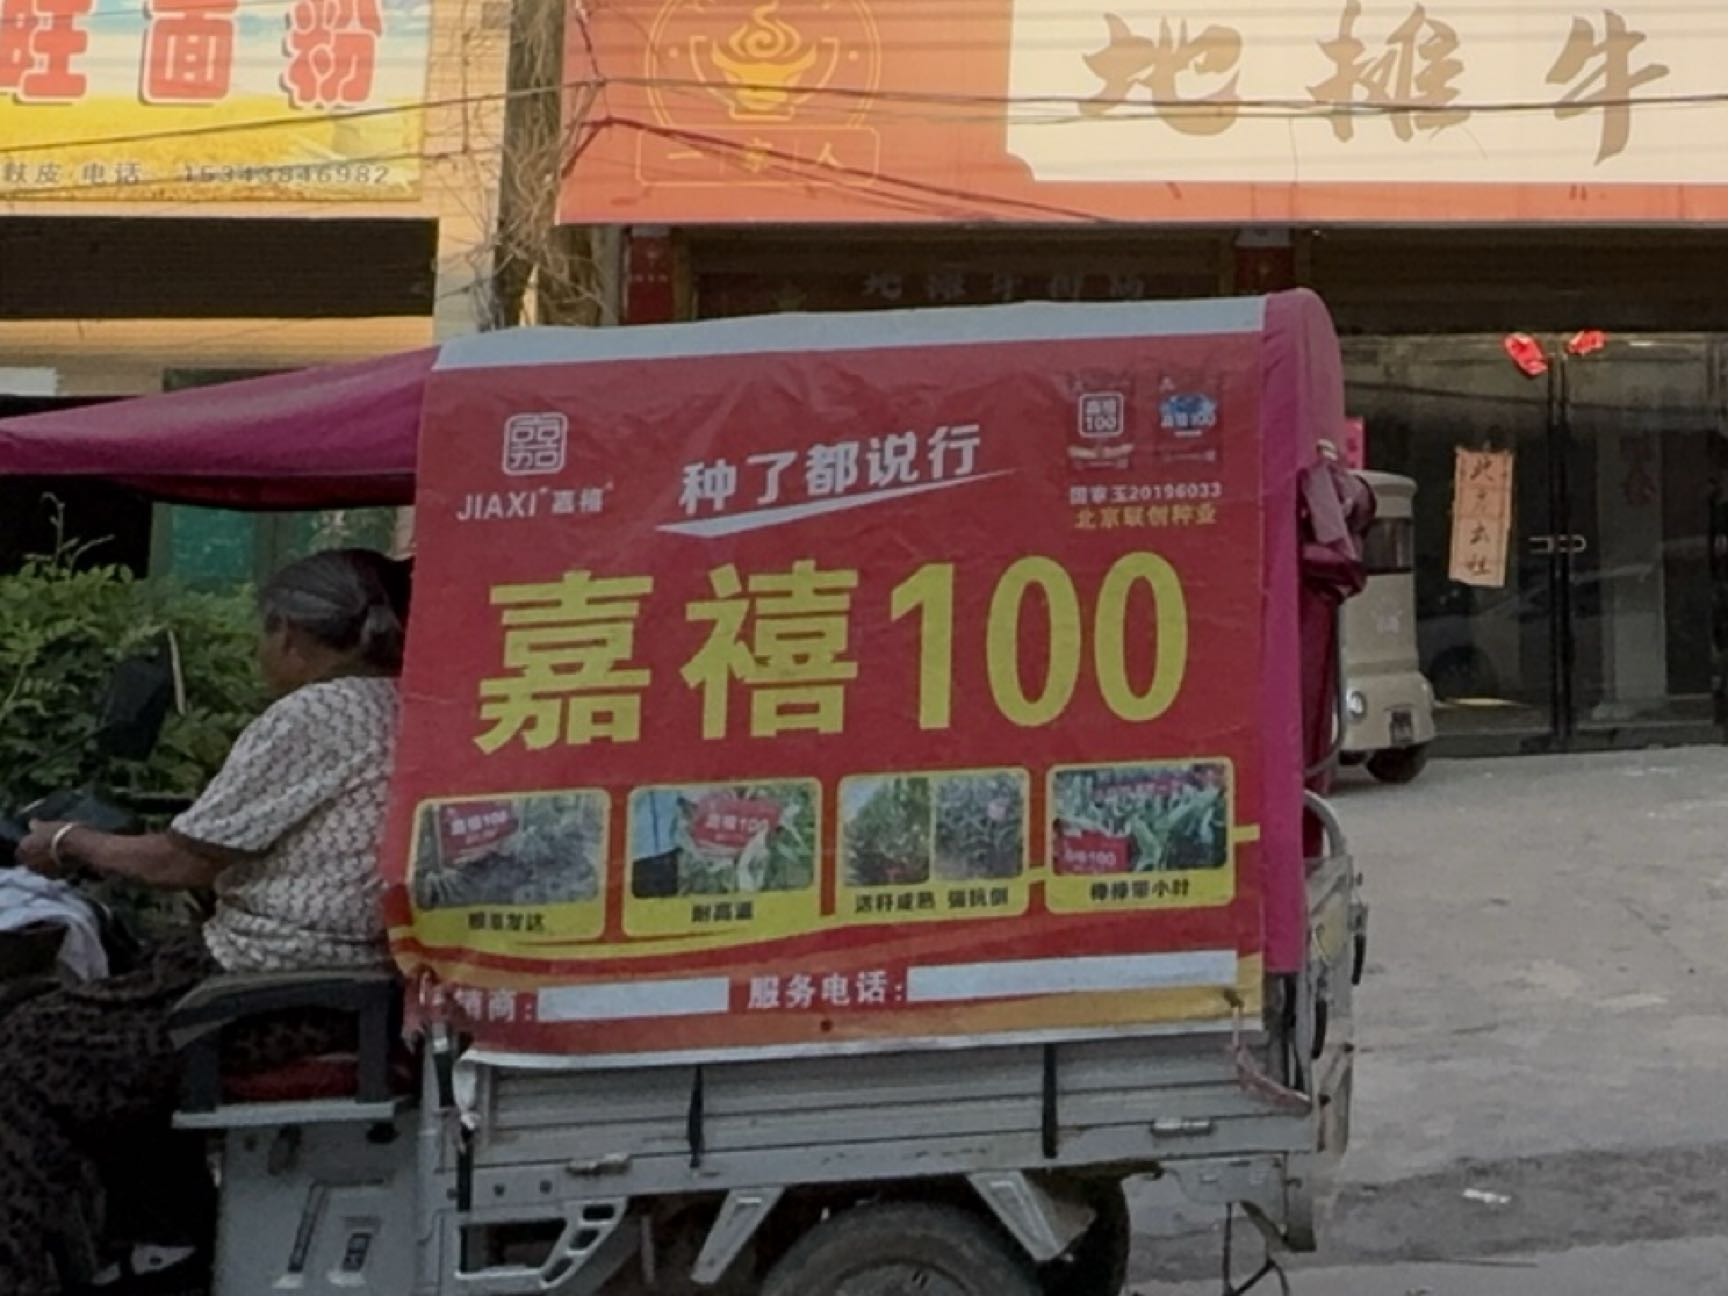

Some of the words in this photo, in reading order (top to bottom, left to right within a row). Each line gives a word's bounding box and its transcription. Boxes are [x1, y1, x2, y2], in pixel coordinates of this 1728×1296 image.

[82, 160, 141, 185] 电话
[678, 423, 981, 515] 种了都说行
[456, 490, 537, 520] JIAXI
[473, 551, 1189, 756] 嘉禧100
